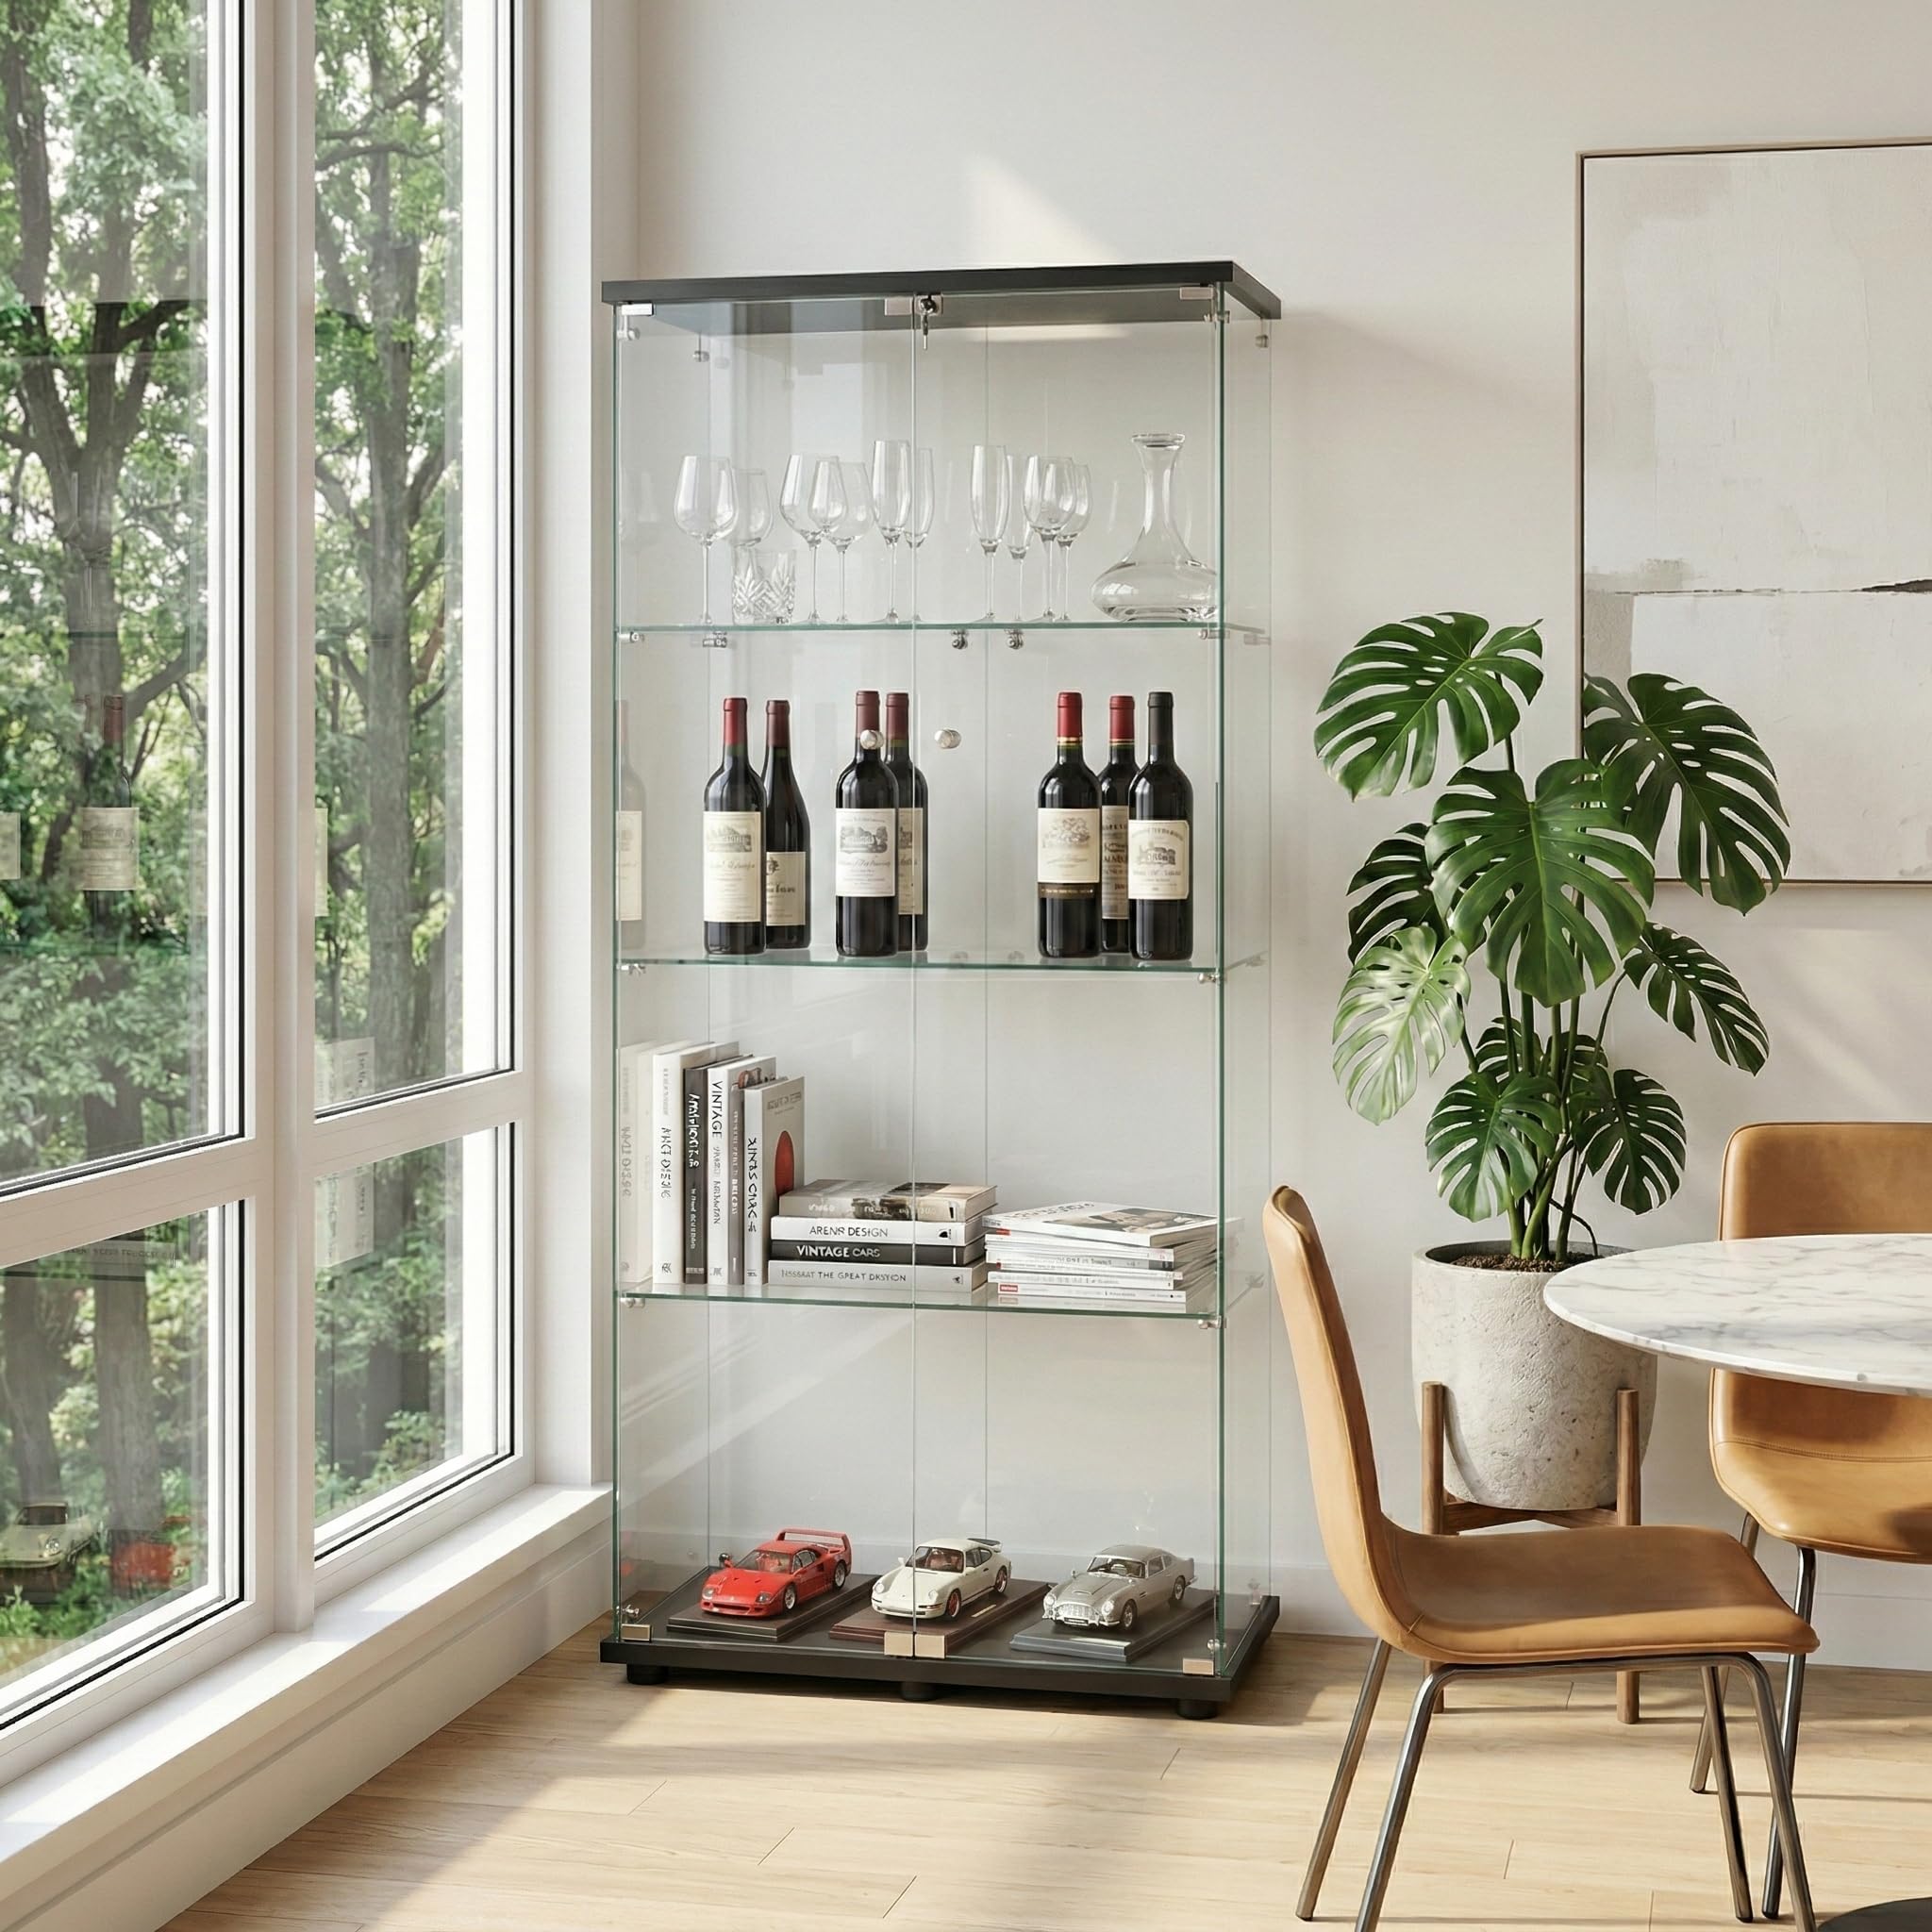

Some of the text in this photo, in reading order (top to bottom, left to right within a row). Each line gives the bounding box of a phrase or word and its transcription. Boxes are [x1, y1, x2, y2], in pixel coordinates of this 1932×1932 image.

[711, 1080, 724, 1140] VINTAGE
[848, 1226, 889, 1238] DESIGN
[796, 1244, 881, 1258] VINTAGE CARS
[818, 1271, 835, 1280] THE
